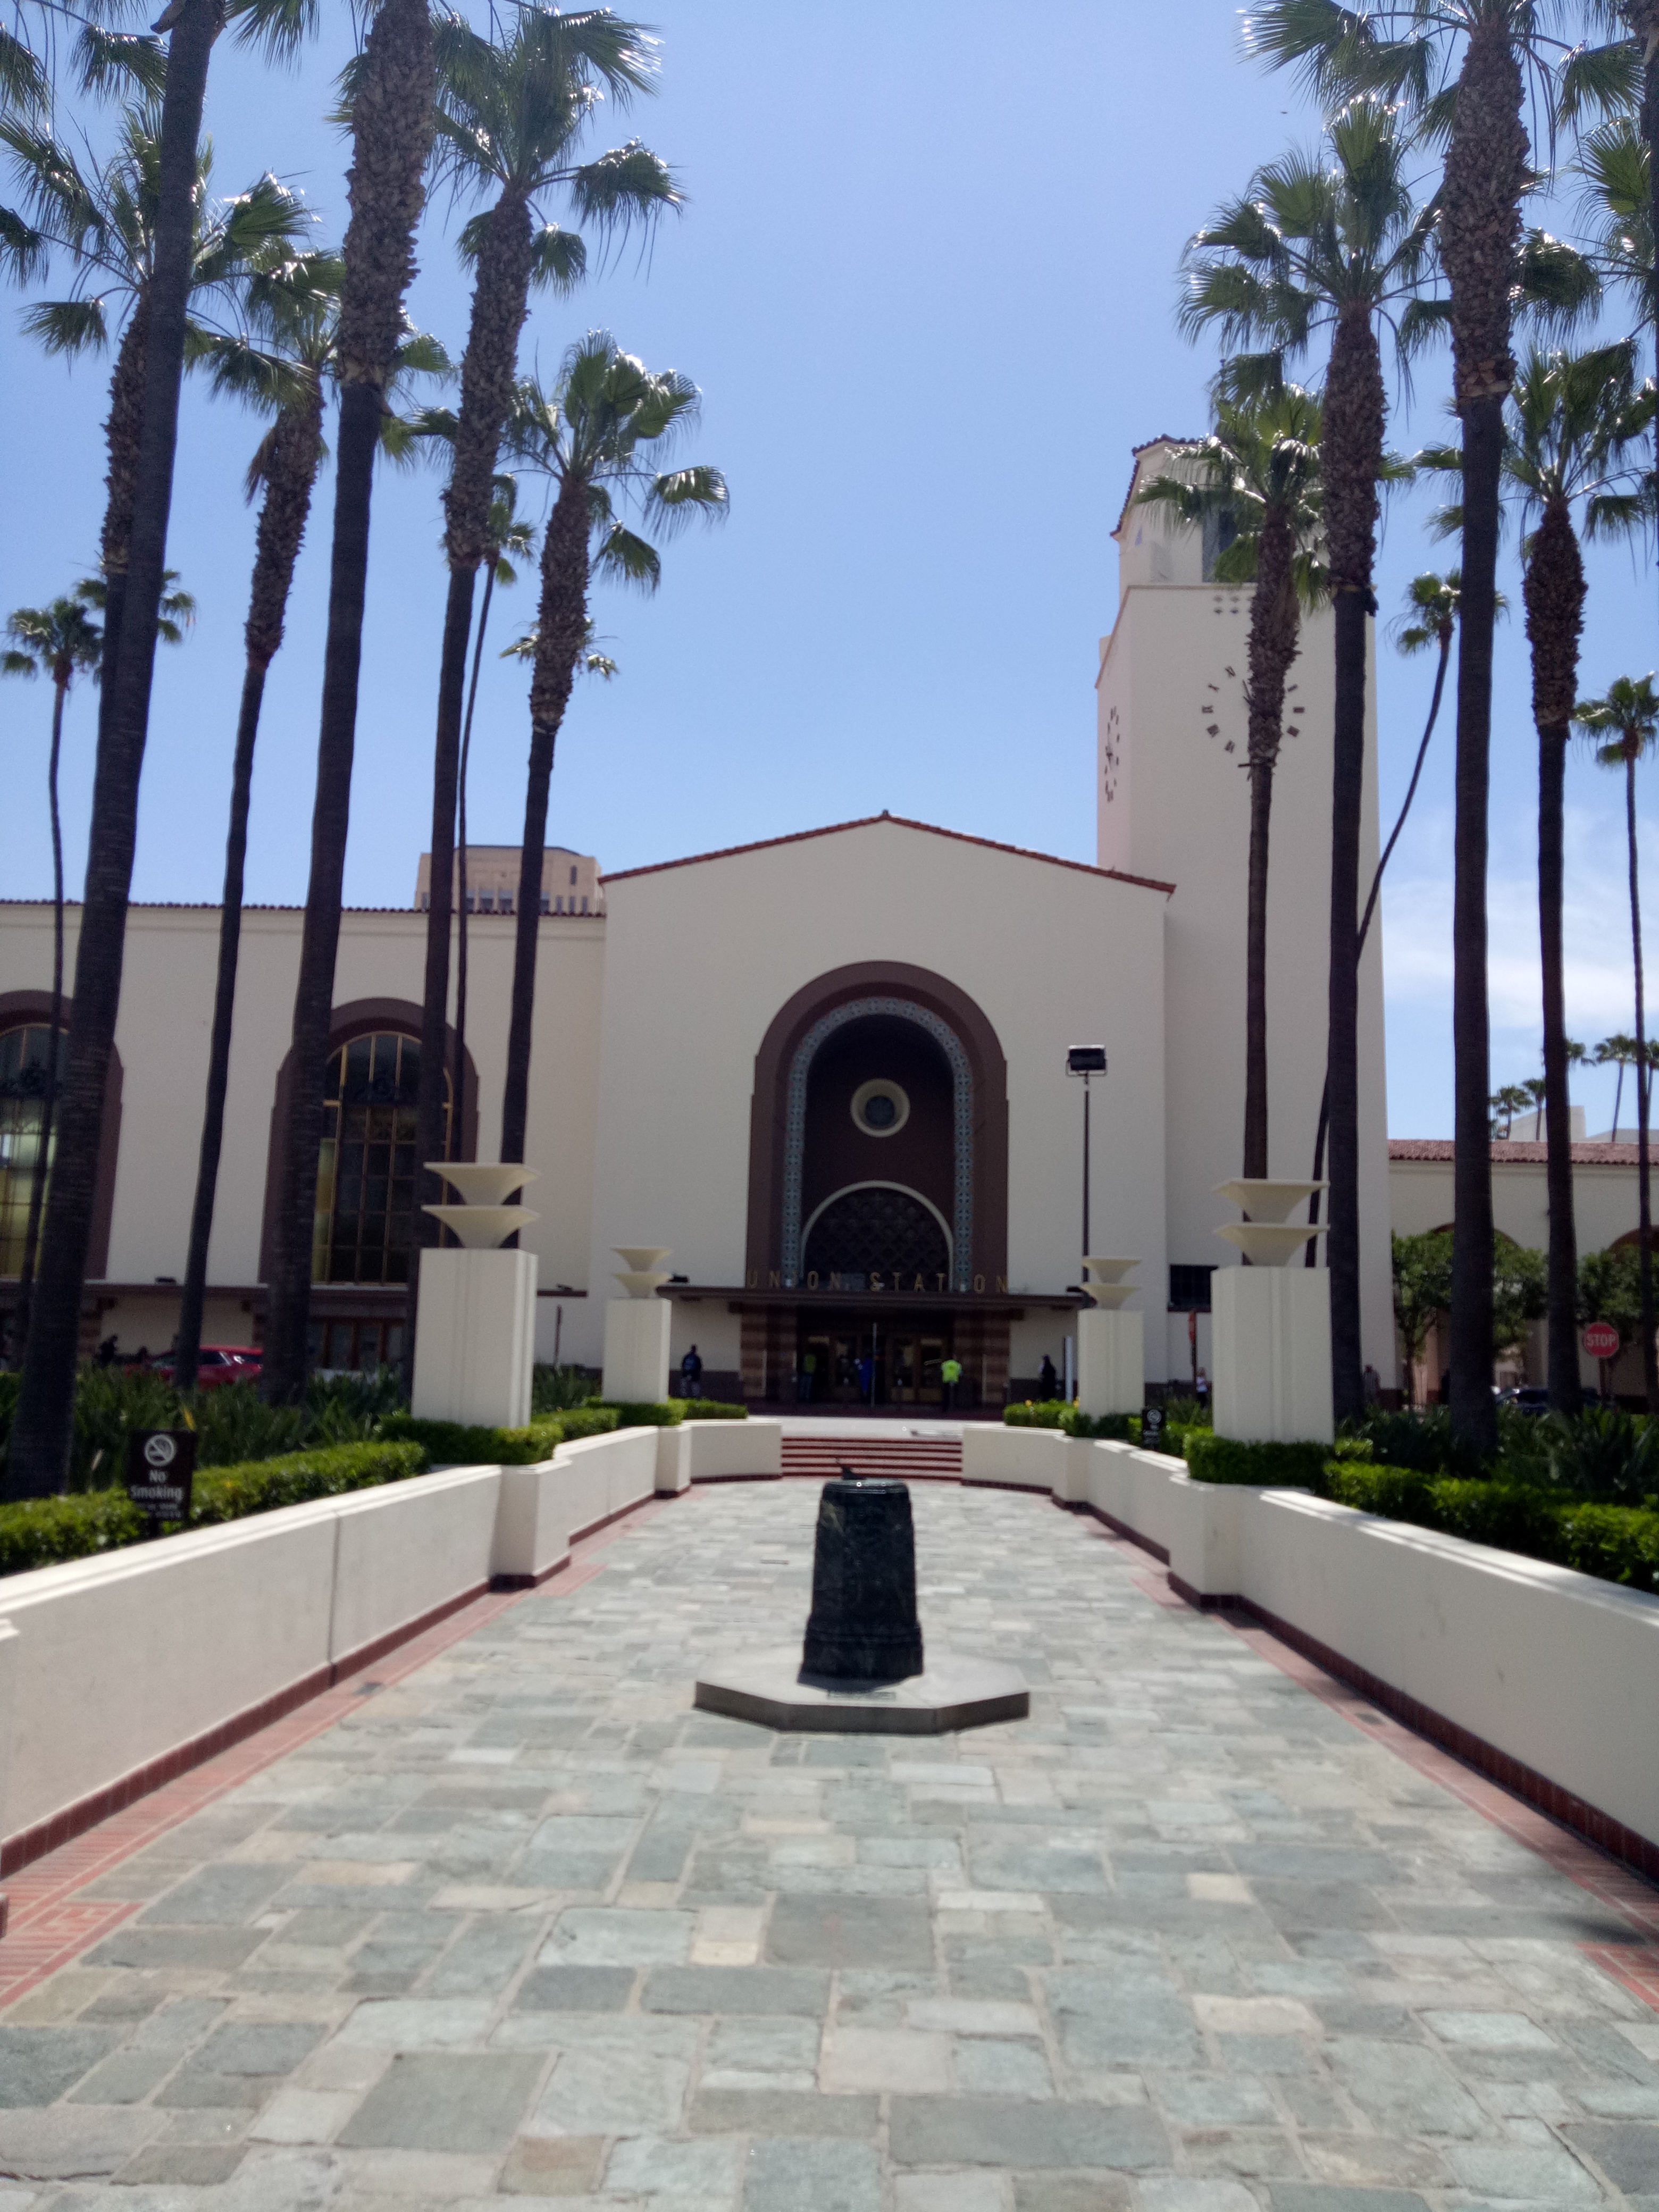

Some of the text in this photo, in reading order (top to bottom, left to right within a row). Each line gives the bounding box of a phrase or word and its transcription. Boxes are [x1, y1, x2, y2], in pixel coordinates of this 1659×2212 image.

[747, 1271, 1008, 1293] UNION STATION
[1586, 1334, 1616, 1347] STOP
